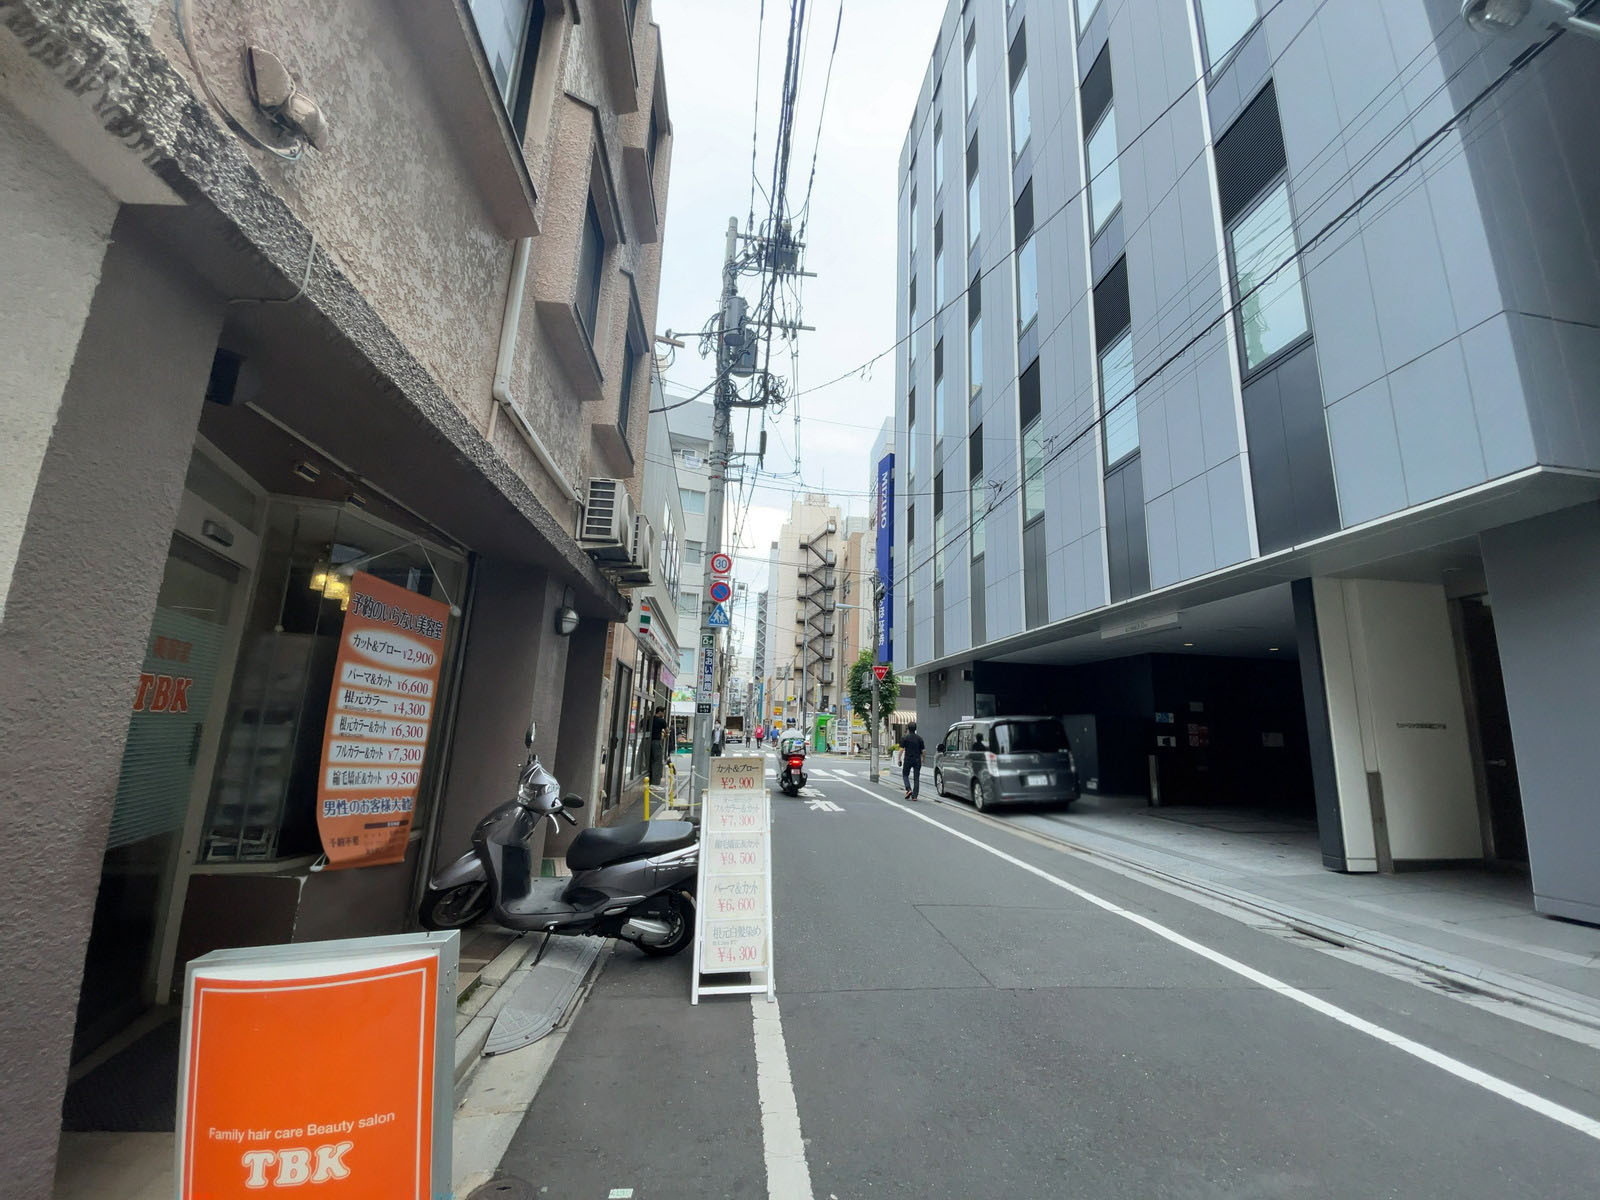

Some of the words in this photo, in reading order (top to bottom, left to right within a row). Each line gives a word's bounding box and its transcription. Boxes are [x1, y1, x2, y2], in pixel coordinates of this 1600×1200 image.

[880, 471, 888, 529] MIZUHO
[715, 559, 728, 569] 30
[351, 592, 443, 640] 予約のいらない美容室
[353, 634, 401, 655] カット&ブロー
[403, 649, 434, 666] ¥2,900
[348, 668, 393, 688] パーマ&カット
[397, 678, 429, 695] ¥6,600
[704, 648, 714, 691] あおい薬局
[133, 673, 193, 713] TBK
[344, 689, 389, 707] 根元カラー
[393, 702, 425, 717] ¥4,300
[391, 724, 424, 739] ¥6,300
[336, 745, 384, 760] フルカラー&カット
[387, 748, 421, 763] ¥7,300
[386, 771, 418, 785] ¥9,500
[717, 764, 760, 774] カット&ブロー
[721, 777, 755, 790] ¥2,900
[208, 1127, 245, 1144] Family
[247, 1125, 271, 1140] hair
[274, 1125, 304, 1140] care
[307, 1120, 354, 1138] Beauty
[357, 1111, 396, 1130] salon
[241, 1141, 354, 1189] TBK
